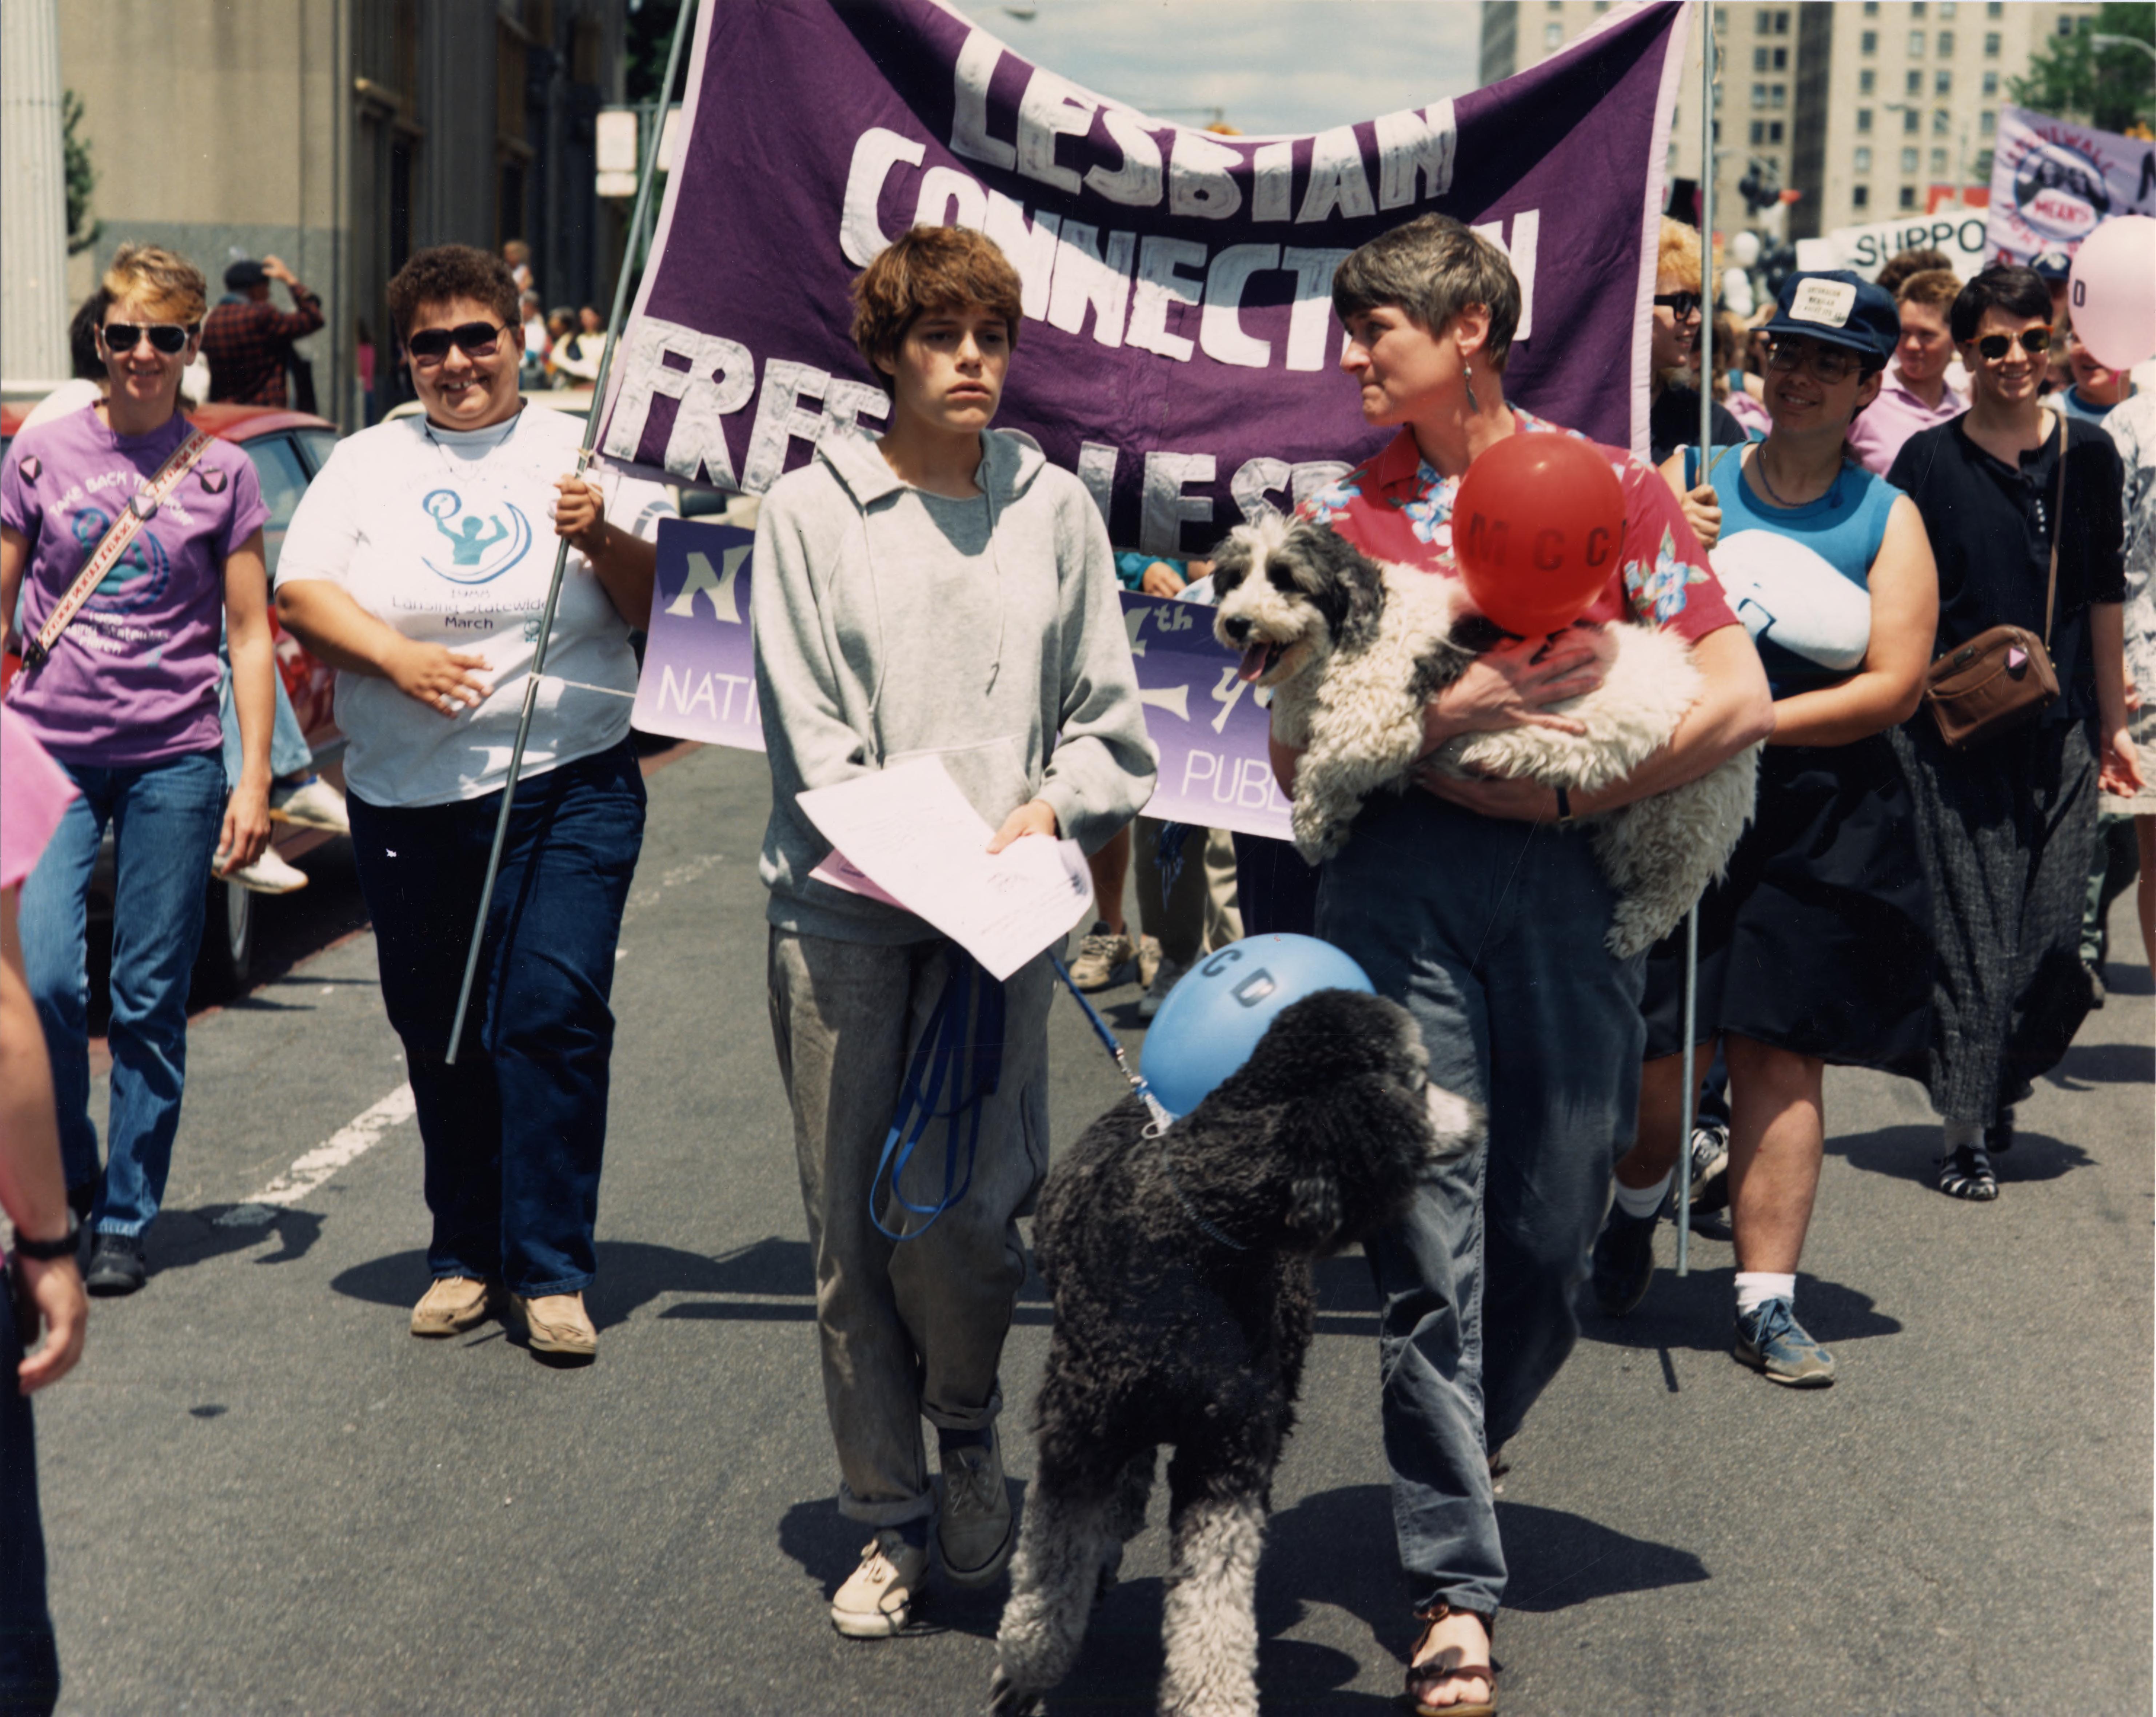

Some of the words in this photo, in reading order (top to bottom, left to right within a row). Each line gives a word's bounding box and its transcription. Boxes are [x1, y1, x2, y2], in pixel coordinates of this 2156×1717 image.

[949, 27, 1455, 223] LESBIAN
[839, 127, 1540, 371] CONNECTN
[85, 470, 127, 494] BACK
[1467, 511, 1628, 572] MCC
[445, 616, 494, 630] March
[657, 664, 762, 725] NATI
